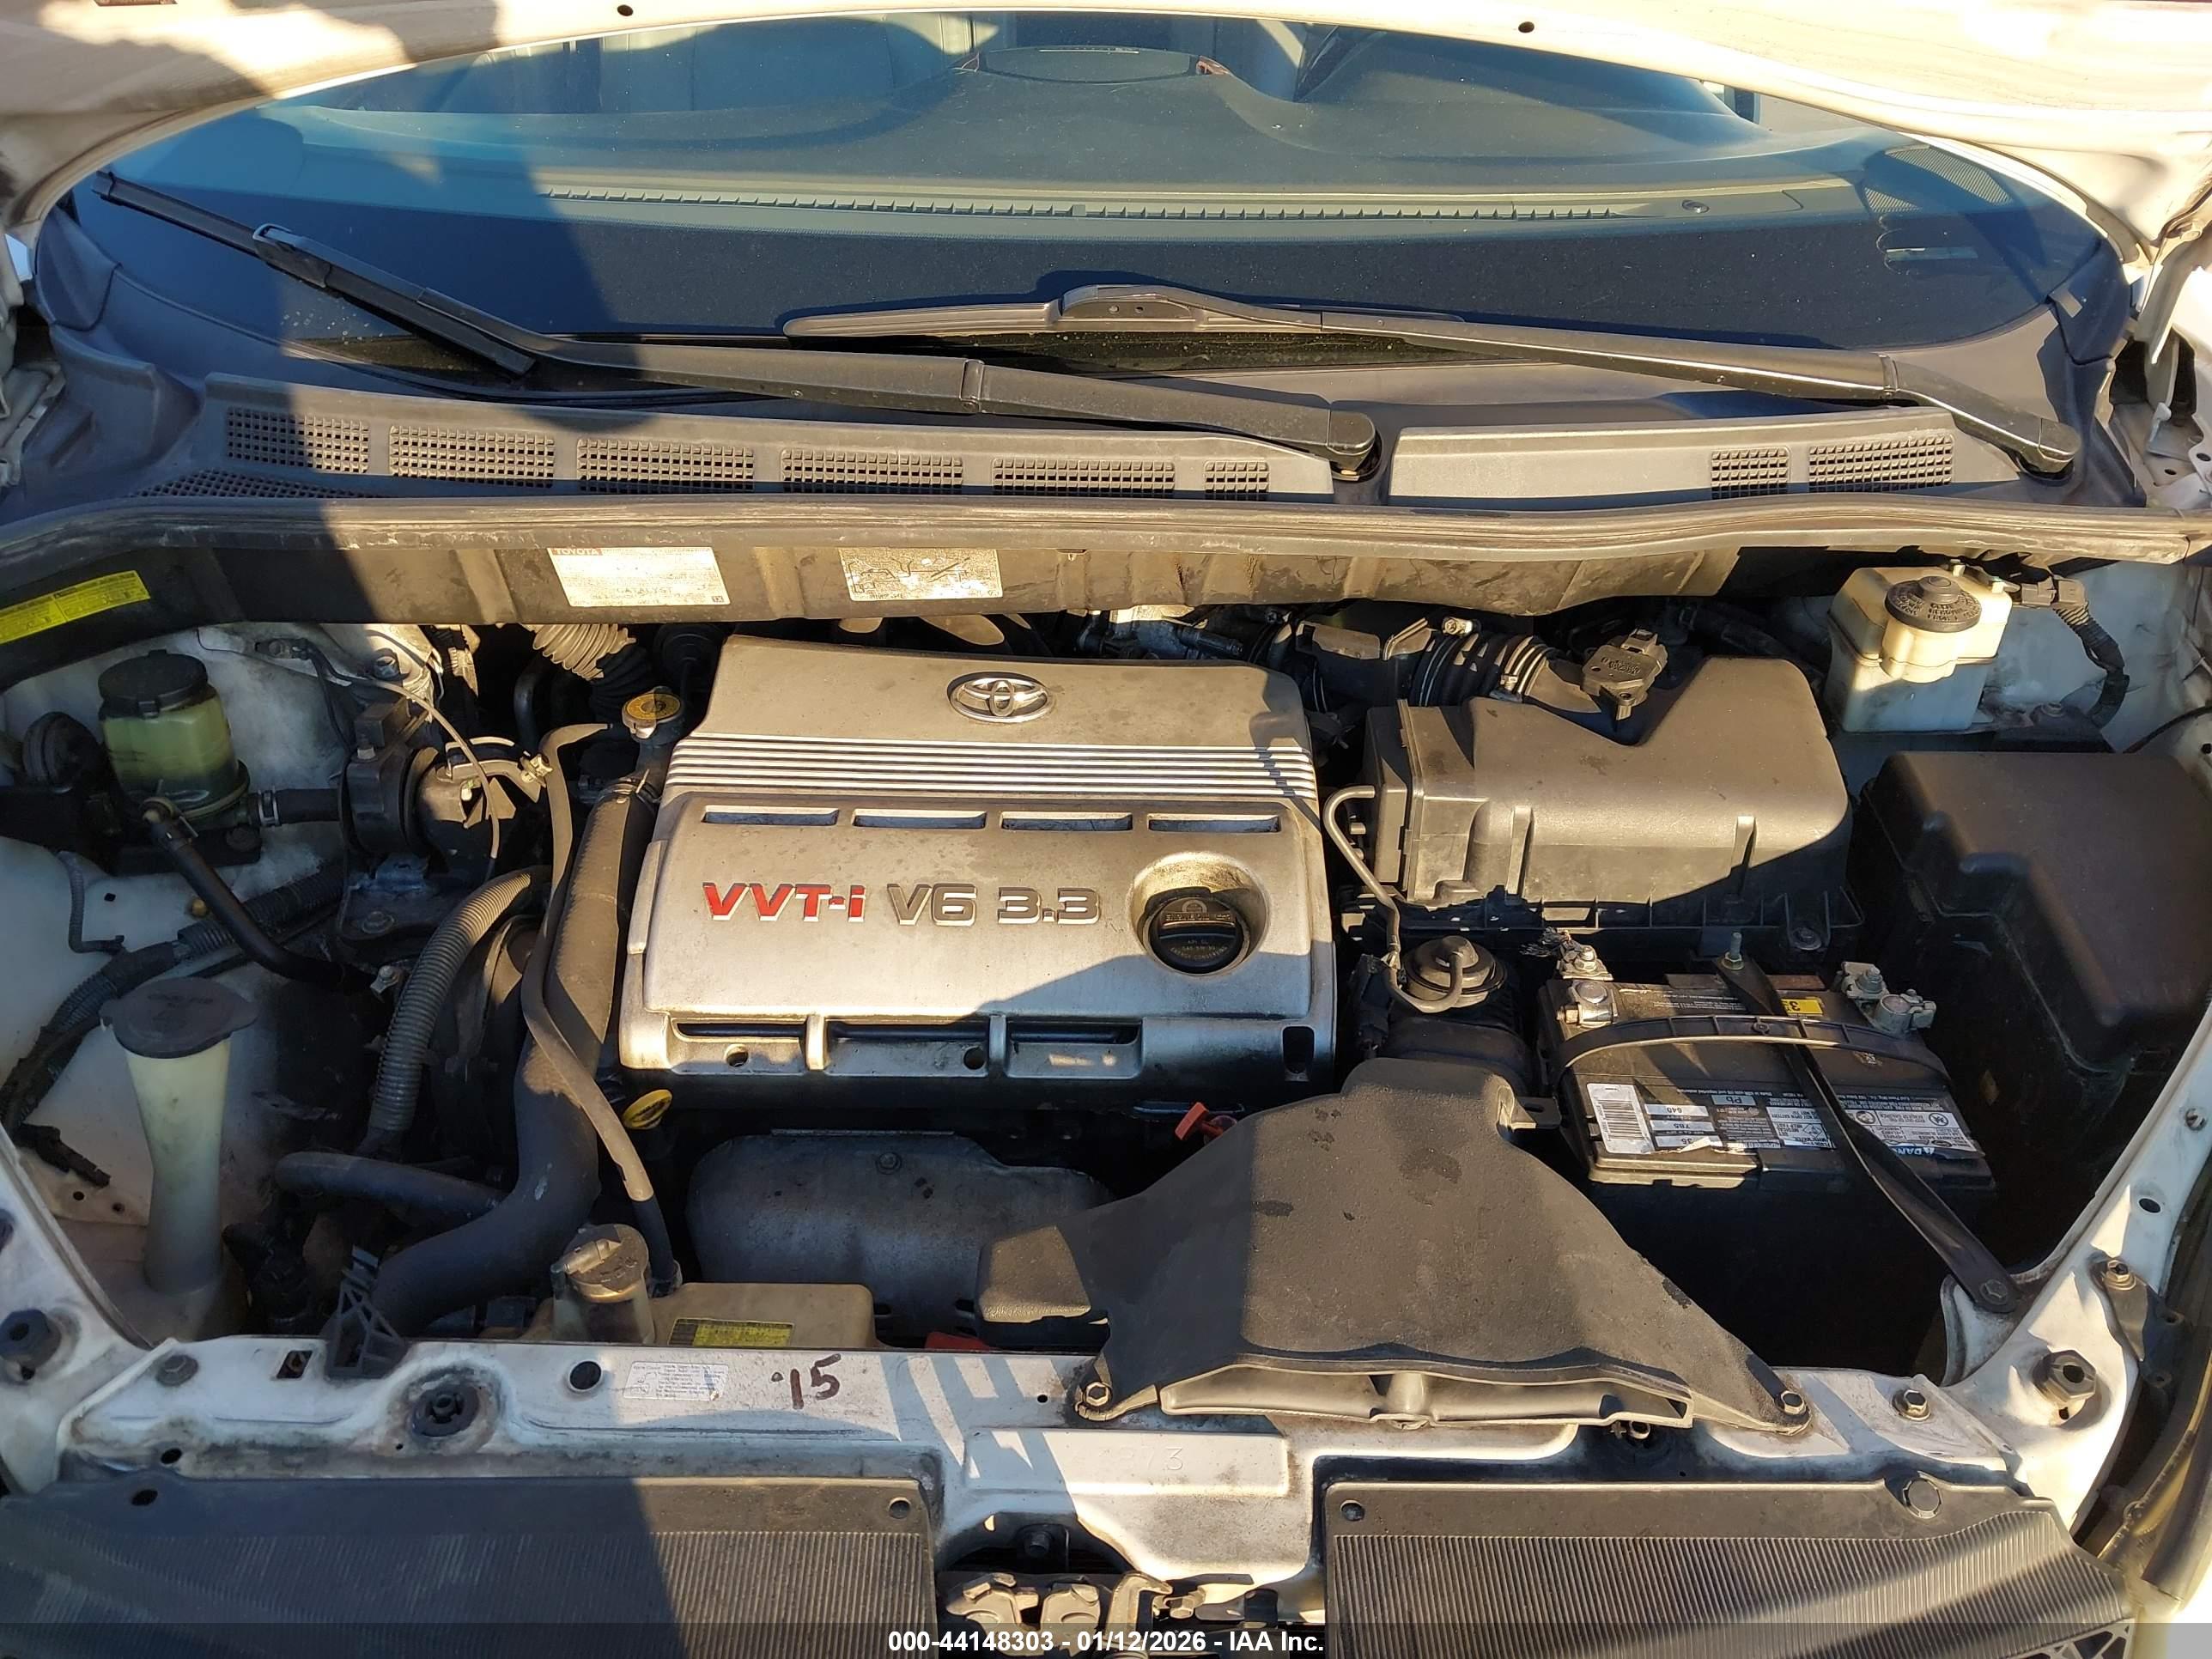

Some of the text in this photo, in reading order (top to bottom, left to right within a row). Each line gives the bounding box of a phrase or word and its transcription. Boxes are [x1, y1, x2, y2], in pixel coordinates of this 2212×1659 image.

[702, 882, 1103, 927] VVT-i V6 3.3
[1789, 1001, 1801, 1012] 3
